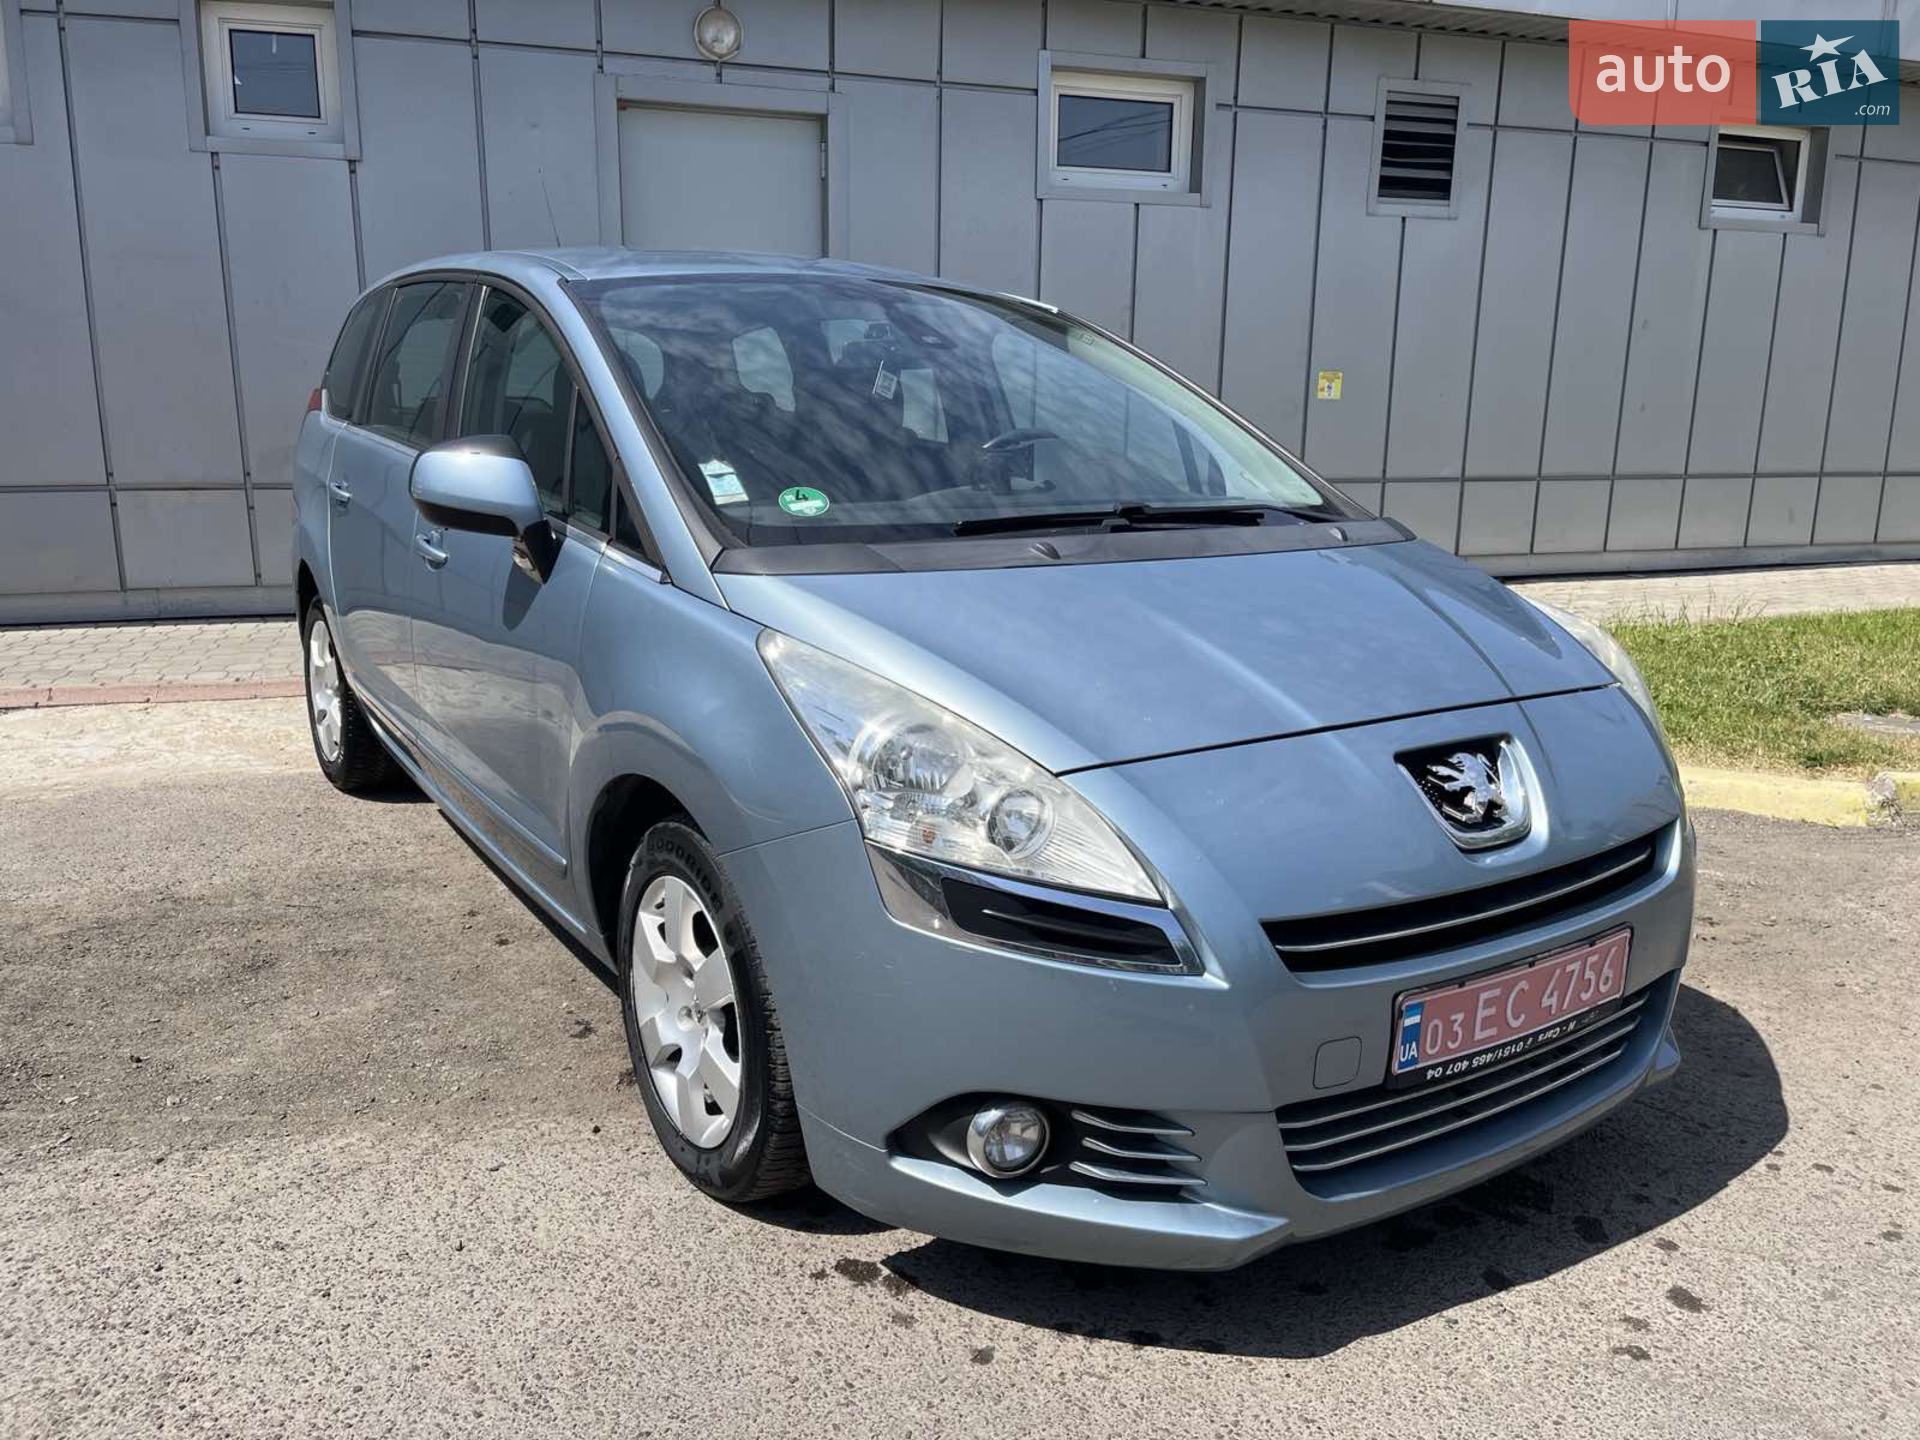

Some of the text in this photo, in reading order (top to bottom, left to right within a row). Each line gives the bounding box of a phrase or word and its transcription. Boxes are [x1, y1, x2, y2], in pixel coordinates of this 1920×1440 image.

[1425, 946, 1618, 1055] 03 EC 4756
[1400, 1041, 1418, 1062] UA
